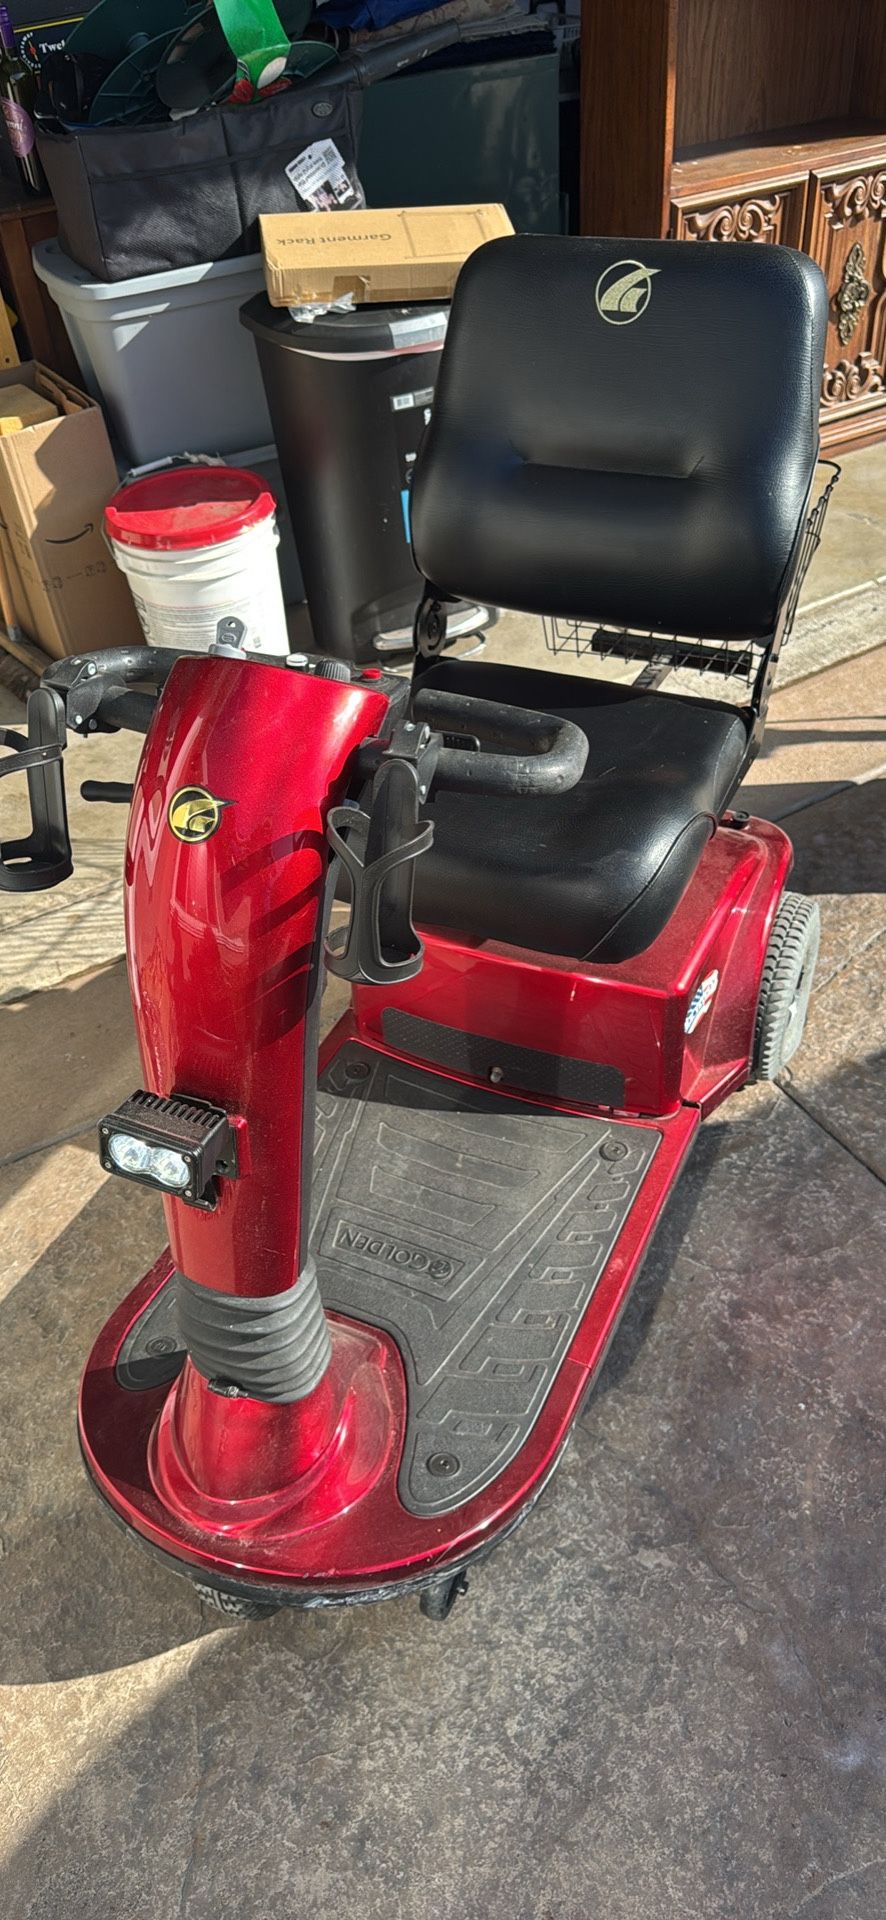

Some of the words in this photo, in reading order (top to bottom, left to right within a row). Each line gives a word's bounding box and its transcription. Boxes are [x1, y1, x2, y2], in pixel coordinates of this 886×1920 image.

[276, 237, 316, 246] Rack
[319, 233, 392, 244] Garment
[339, 1228, 431, 1272] GOLDEN
